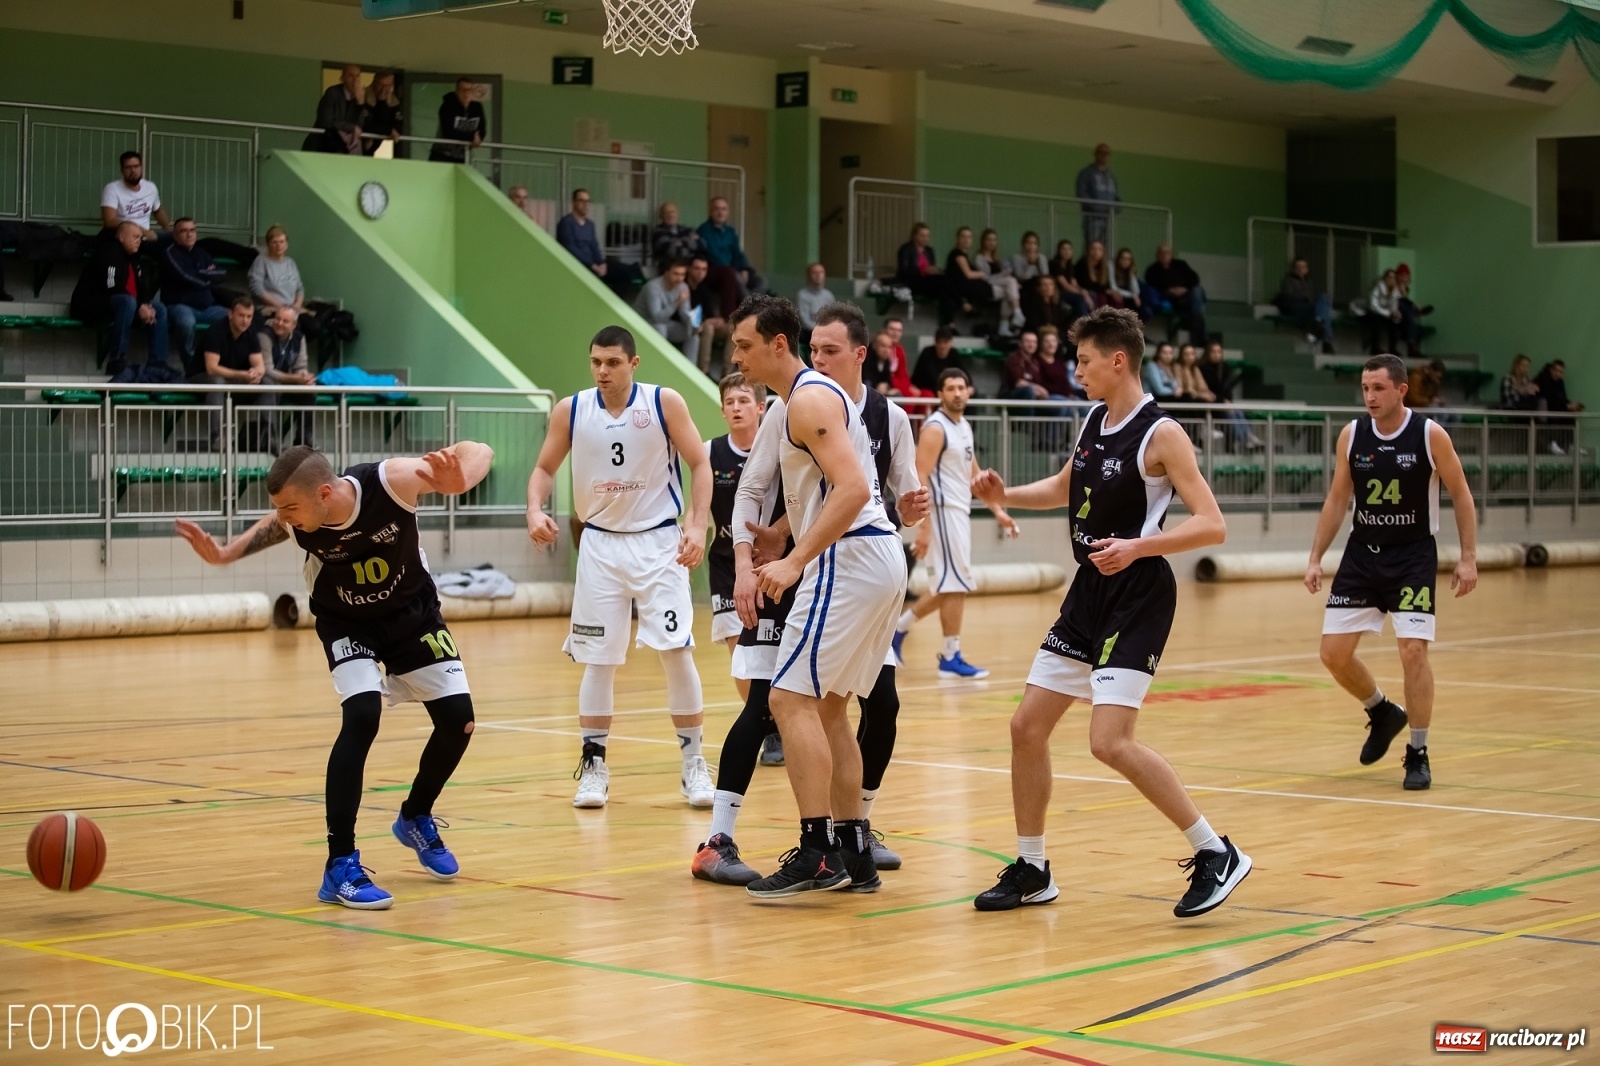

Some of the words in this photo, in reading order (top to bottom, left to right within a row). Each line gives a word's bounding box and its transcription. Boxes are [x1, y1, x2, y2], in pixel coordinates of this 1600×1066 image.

[564, 66, 583, 82] F
[785, 85, 801, 103] F
[611, 442, 625, 466] 3
[1366, 479, 1402, 504] 24
[1357, 510, 1416, 525] Nacomi
[352, 557, 390, 584] 10
[1398, 586, 1432, 611] 24
[664, 610, 678, 633] 3
[420, 629, 458, 660] 10
[1099, 631, 1119, 666] 1
